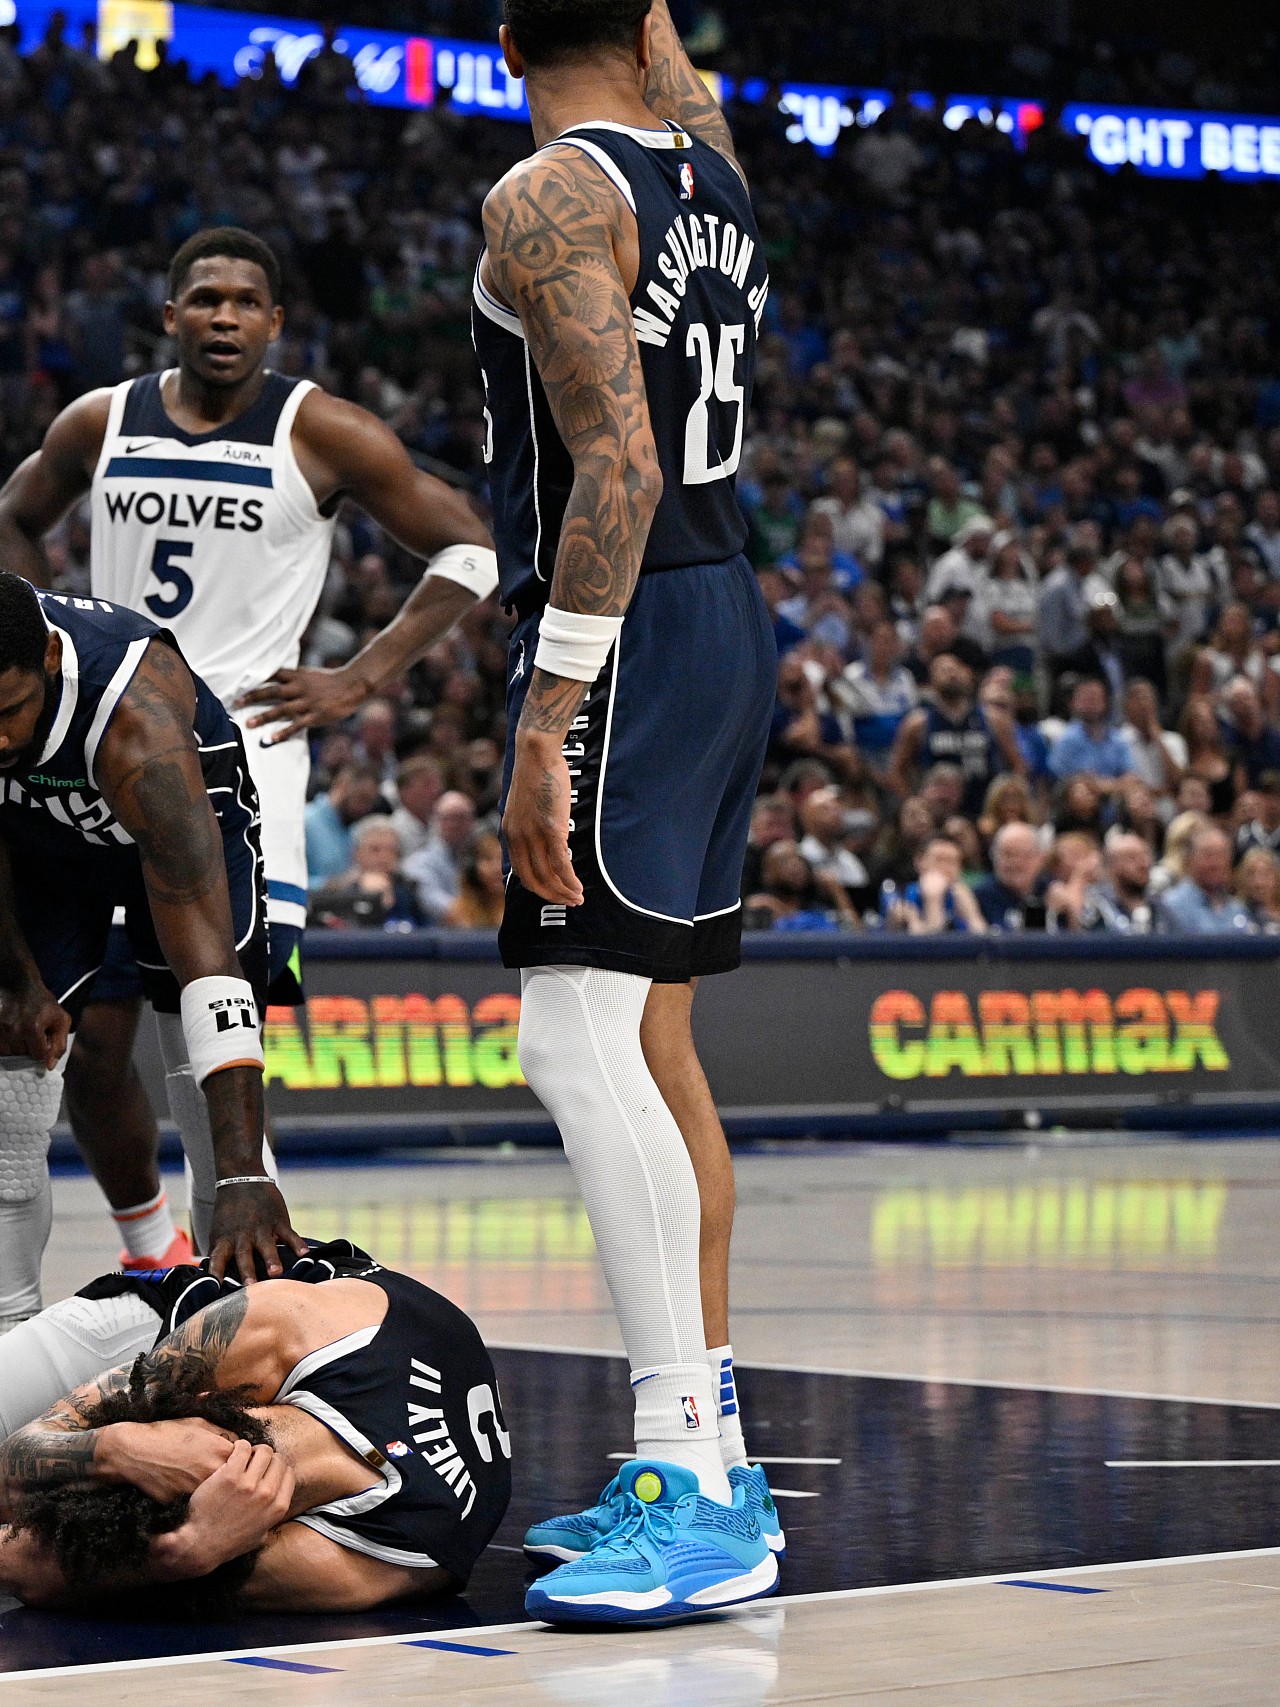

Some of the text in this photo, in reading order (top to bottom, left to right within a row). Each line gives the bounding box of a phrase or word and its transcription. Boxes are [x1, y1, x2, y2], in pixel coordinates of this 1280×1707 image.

[683, 323, 745, 485] 25
[105, 491, 264, 533] WOLVES
[144, 539, 194, 619] 5
[28, 774, 87, 788] chime
[407, 1402, 477, 1521] LIVELY
